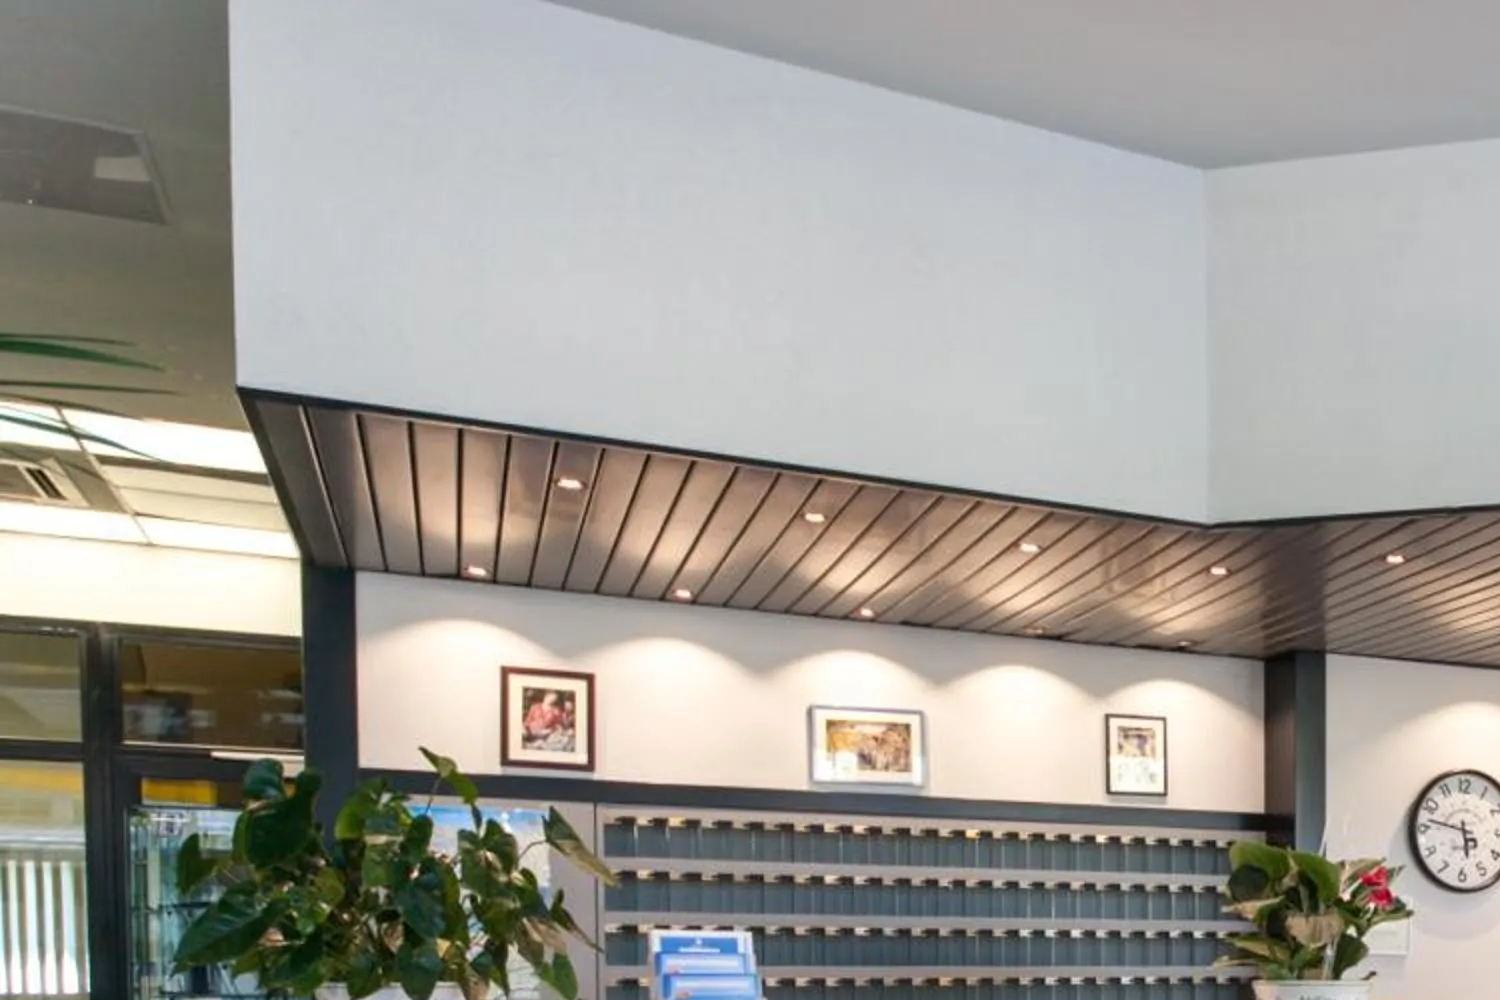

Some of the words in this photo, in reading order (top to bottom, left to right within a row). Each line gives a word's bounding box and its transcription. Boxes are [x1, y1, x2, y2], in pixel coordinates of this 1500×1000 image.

[1439, 783, 1451, 797] 11
[1459, 778, 1472, 794] 12
[1480, 786, 1488, 800] 1
[1422, 799, 1439, 814] 10
[1417, 824, 1431, 835] 9
[1437, 860, 1450, 874] 7
[1475, 862, 1487, 877] 5
[1458, 868, 1467, 883] 6
